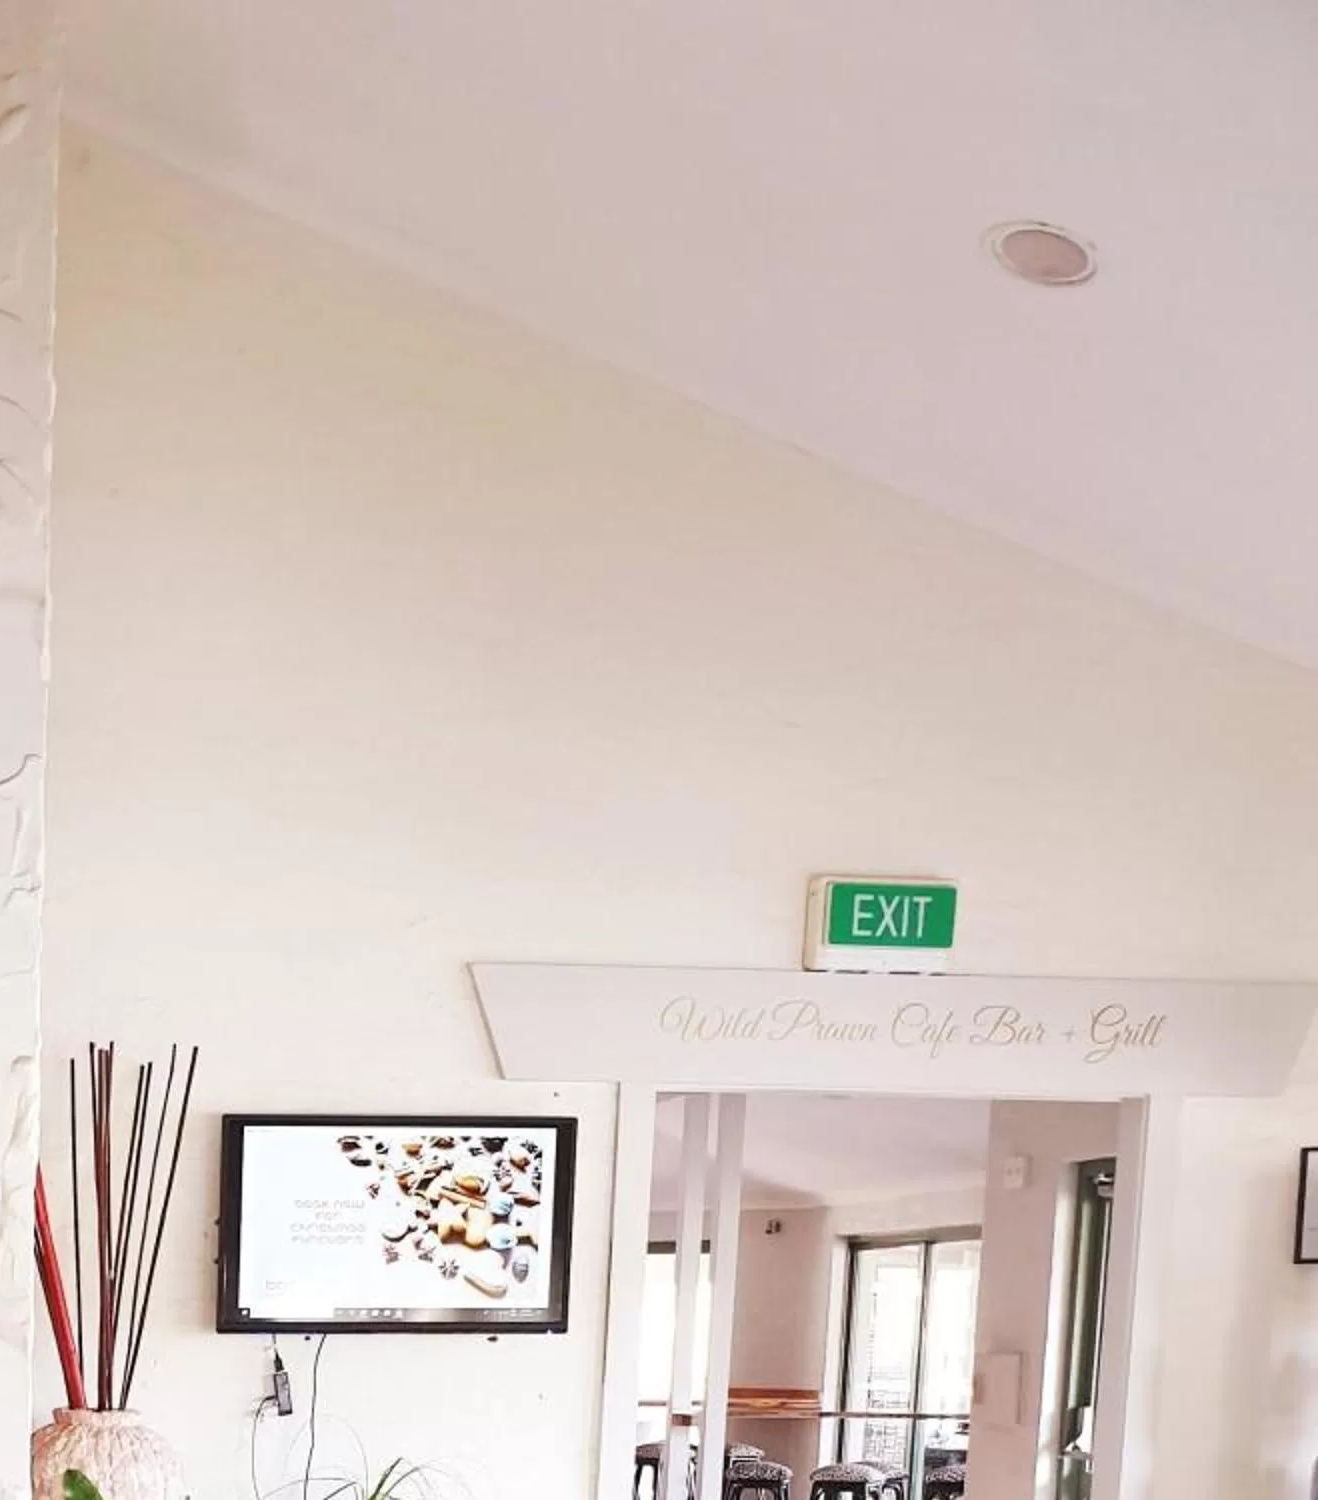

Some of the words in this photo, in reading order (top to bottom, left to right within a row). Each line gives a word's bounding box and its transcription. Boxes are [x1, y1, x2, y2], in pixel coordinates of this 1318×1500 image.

[851, 893, 934, 939] EXIT
[660, 996, 766, 1042] Wild
[767, 998, 878, 1042] Prawn
[890, 1002, 956, 1060] Cafe
[968, 1004, 1047, 1047] Bar
[1059, 1024, 1076, 1044] +
[1082, 1003, 1168, 1065] Grill
